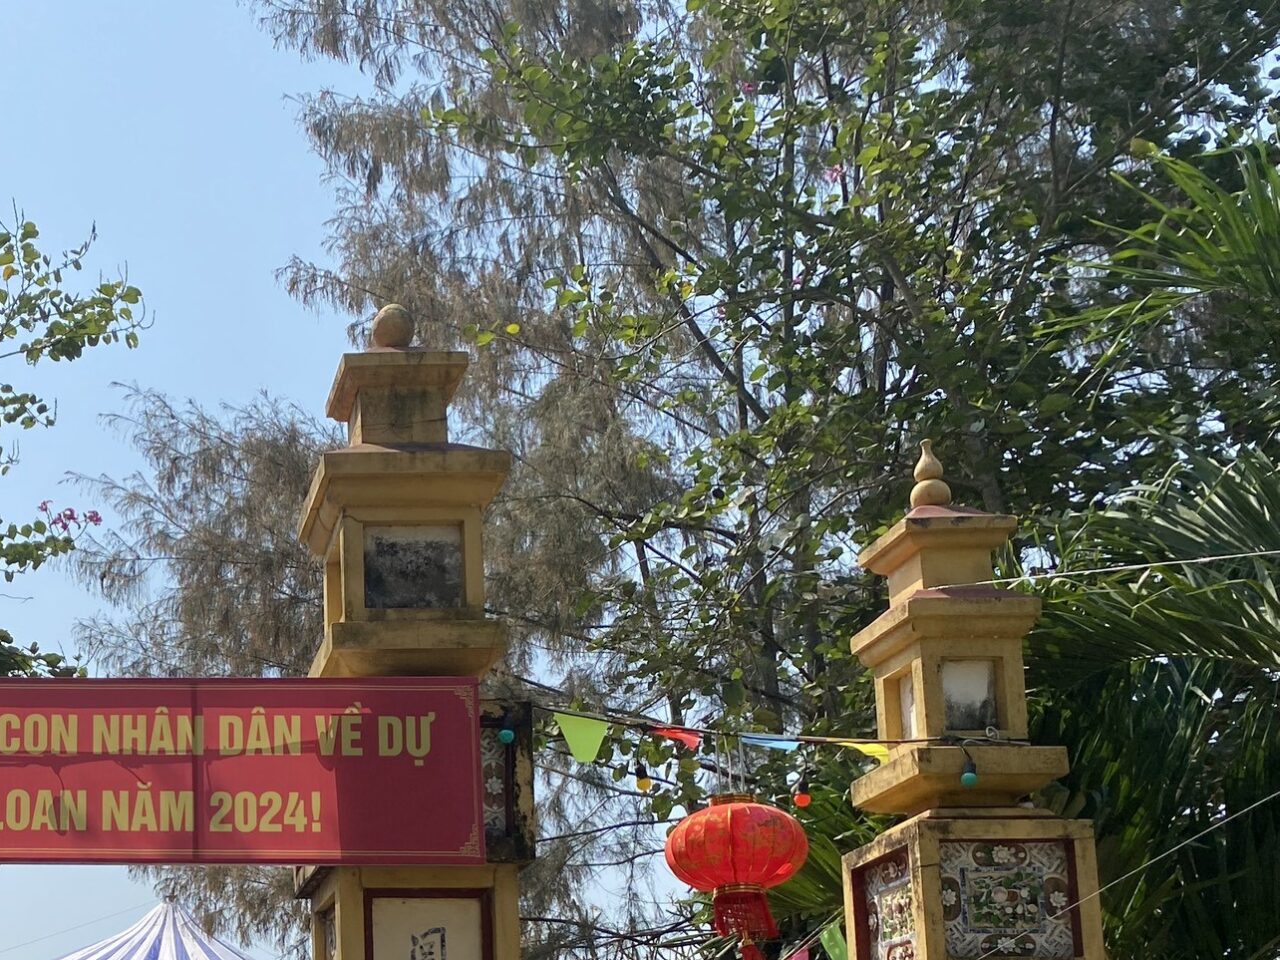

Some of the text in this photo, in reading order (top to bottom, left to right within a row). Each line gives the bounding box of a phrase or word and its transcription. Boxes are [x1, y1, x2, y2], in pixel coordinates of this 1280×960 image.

[92, 706, 205, 756] NHÂN
[219, 706, 302, 757] DÂN
[315, 702, 364, 757] VỀ
[378, 711, 436, 767] DỰ
[101, 782, 195, 833] NĂM
[208, 790, 322, 834] 2024!
